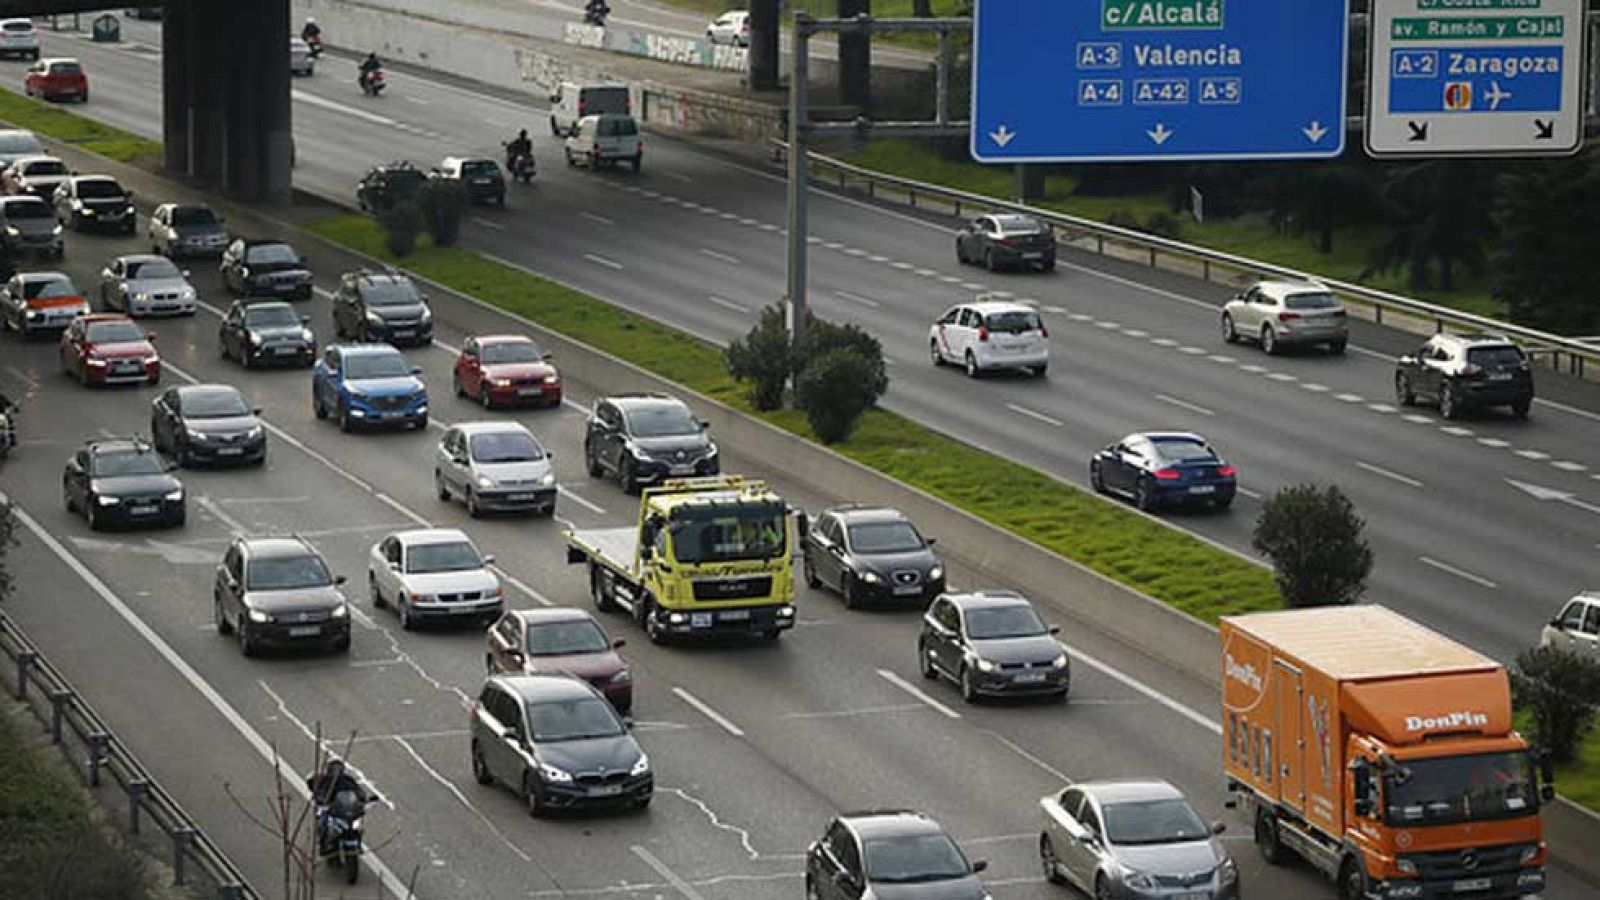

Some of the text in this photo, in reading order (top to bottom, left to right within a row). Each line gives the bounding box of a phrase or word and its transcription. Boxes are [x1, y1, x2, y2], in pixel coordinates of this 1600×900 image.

[1106, 1, 1219, 24] c/Alcalá
[1393, 19, 1562, 36] av. Ramón y Cajal
[1134, 44, 1242, 66] Valencia
[1448, 53, 1559, 78] Zaragoza
[1405, 711, 1489, 731] DonPin
